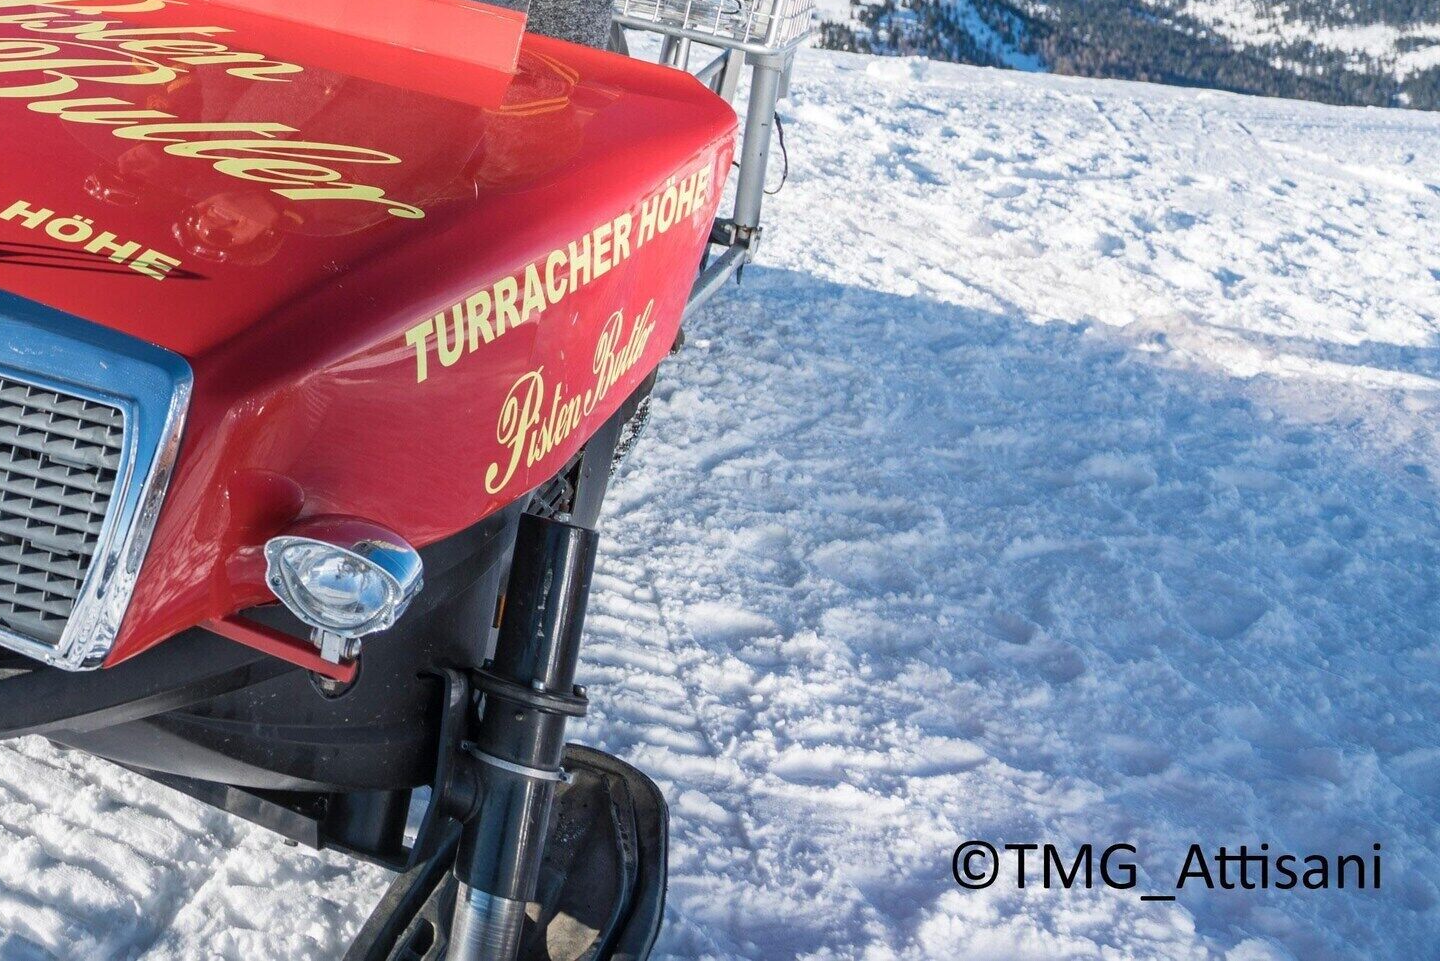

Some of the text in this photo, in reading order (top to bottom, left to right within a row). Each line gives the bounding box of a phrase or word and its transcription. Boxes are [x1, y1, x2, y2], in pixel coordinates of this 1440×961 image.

[404, 164, 712, 384] TURRACHER HÖHE
[484, 298, 657, 495] Pisten Butler
